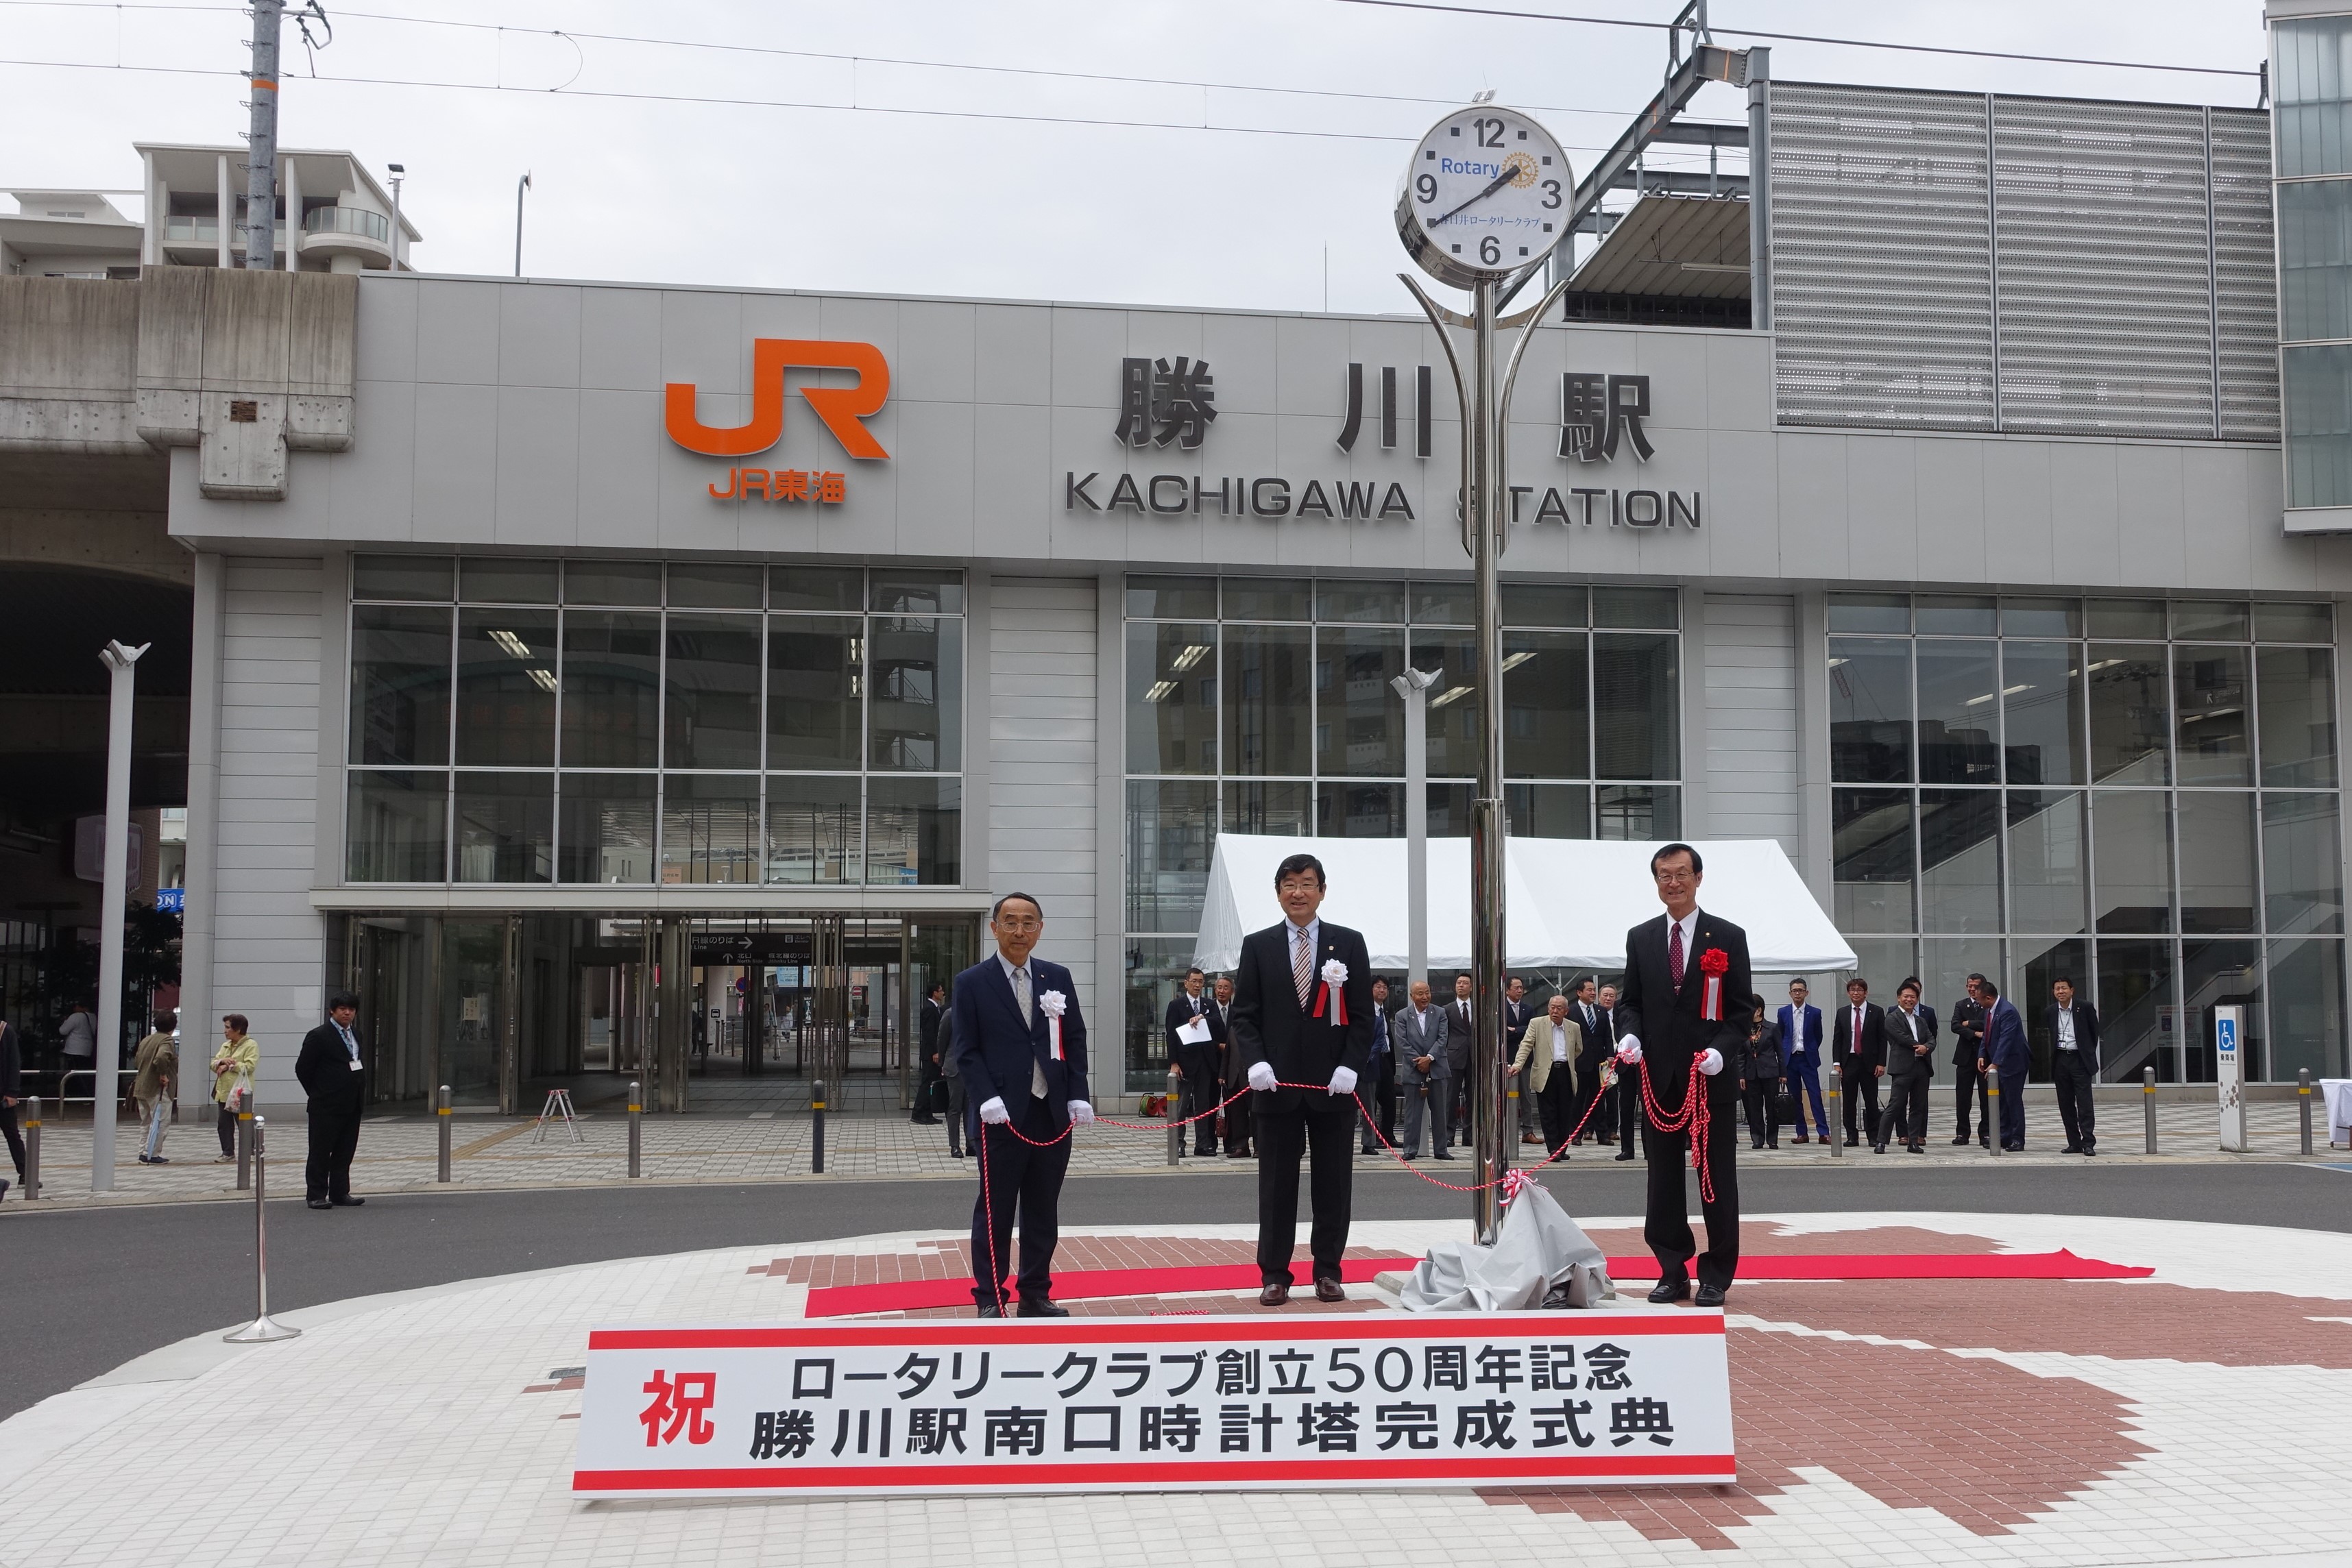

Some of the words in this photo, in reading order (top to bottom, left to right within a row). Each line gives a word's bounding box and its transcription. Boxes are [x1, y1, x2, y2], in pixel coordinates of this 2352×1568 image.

[1473, 118, 1505, 148] 12
[1441, 158, 1500, 179] Rotary
[1416, 173, 1438, 204] 9
[1541, 180, 1562, 209] 3
[1479, 236, 1501, 265] 6
[665, 338, 890, 460] JR
[709, 469, 847, 504] JR東海
[1067, 471, 1415, 524] KACHIGAWA
[791, 1343, 1634, 1401] ロータリークラブ創立50周年記念
[639, 1369, 716, 1447] 祝
[749, 1397, 1675, 1460] 勝川駅南口時計塔完成式典
